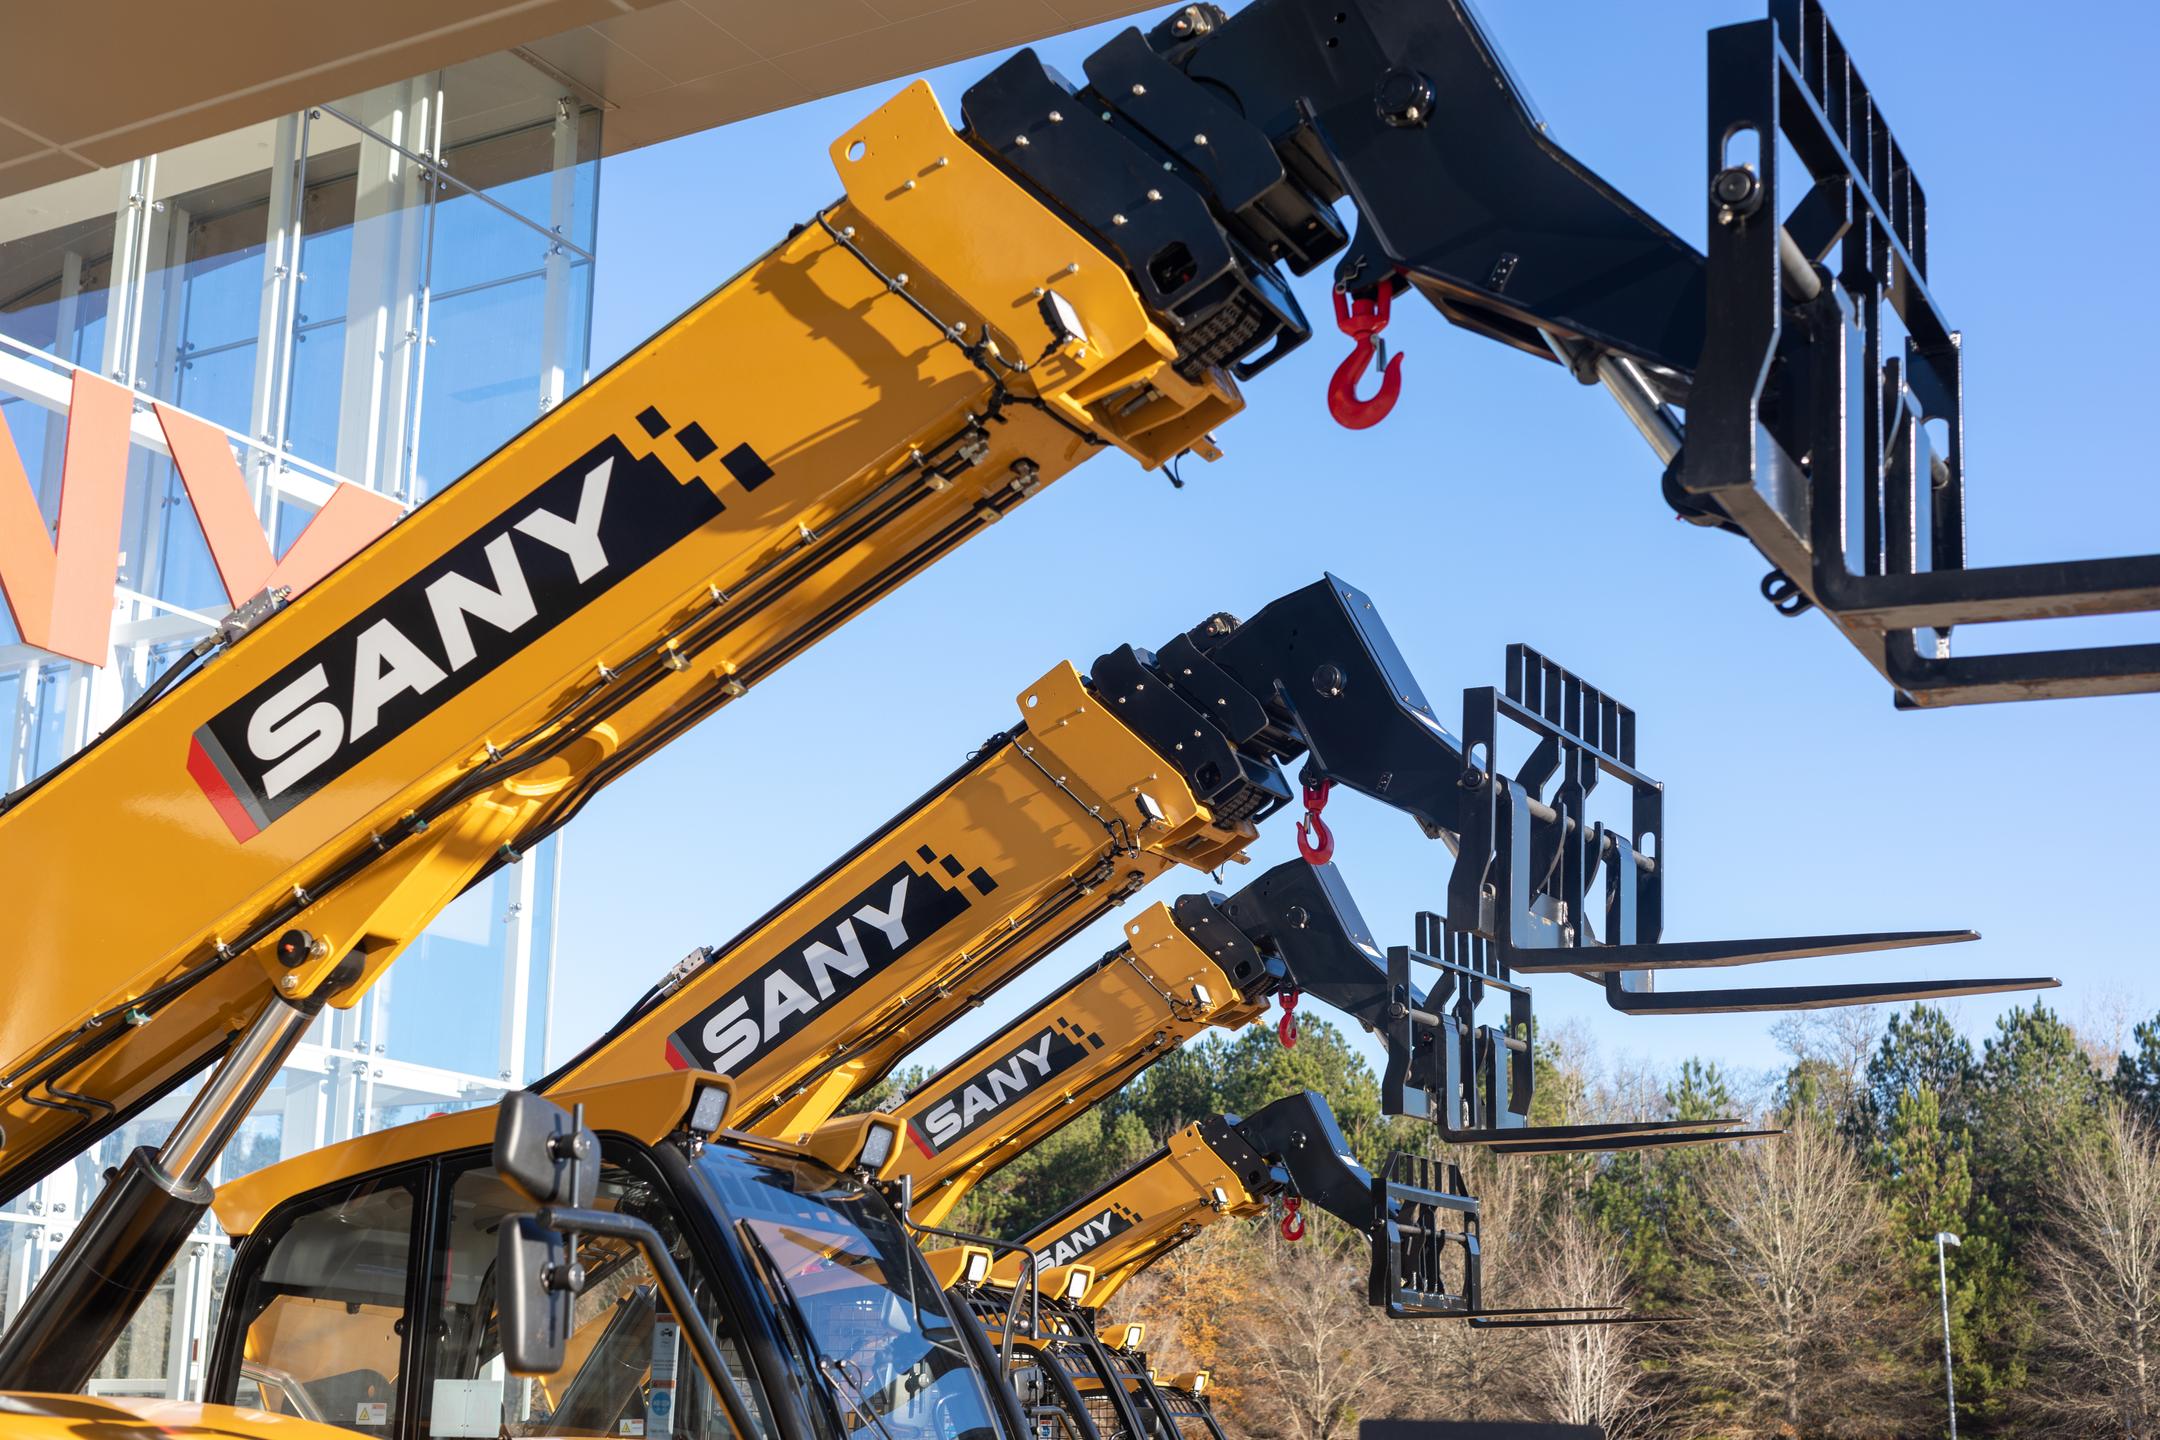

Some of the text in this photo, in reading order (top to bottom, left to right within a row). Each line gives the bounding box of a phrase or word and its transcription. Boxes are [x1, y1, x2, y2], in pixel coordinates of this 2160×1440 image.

[247, 456, 615, 799] SANY
[702, 876, 908, 1075] SANY
[926, 1032, 1051, 1146] SANY
[1037, 1211, 1112, 1275] SANY
